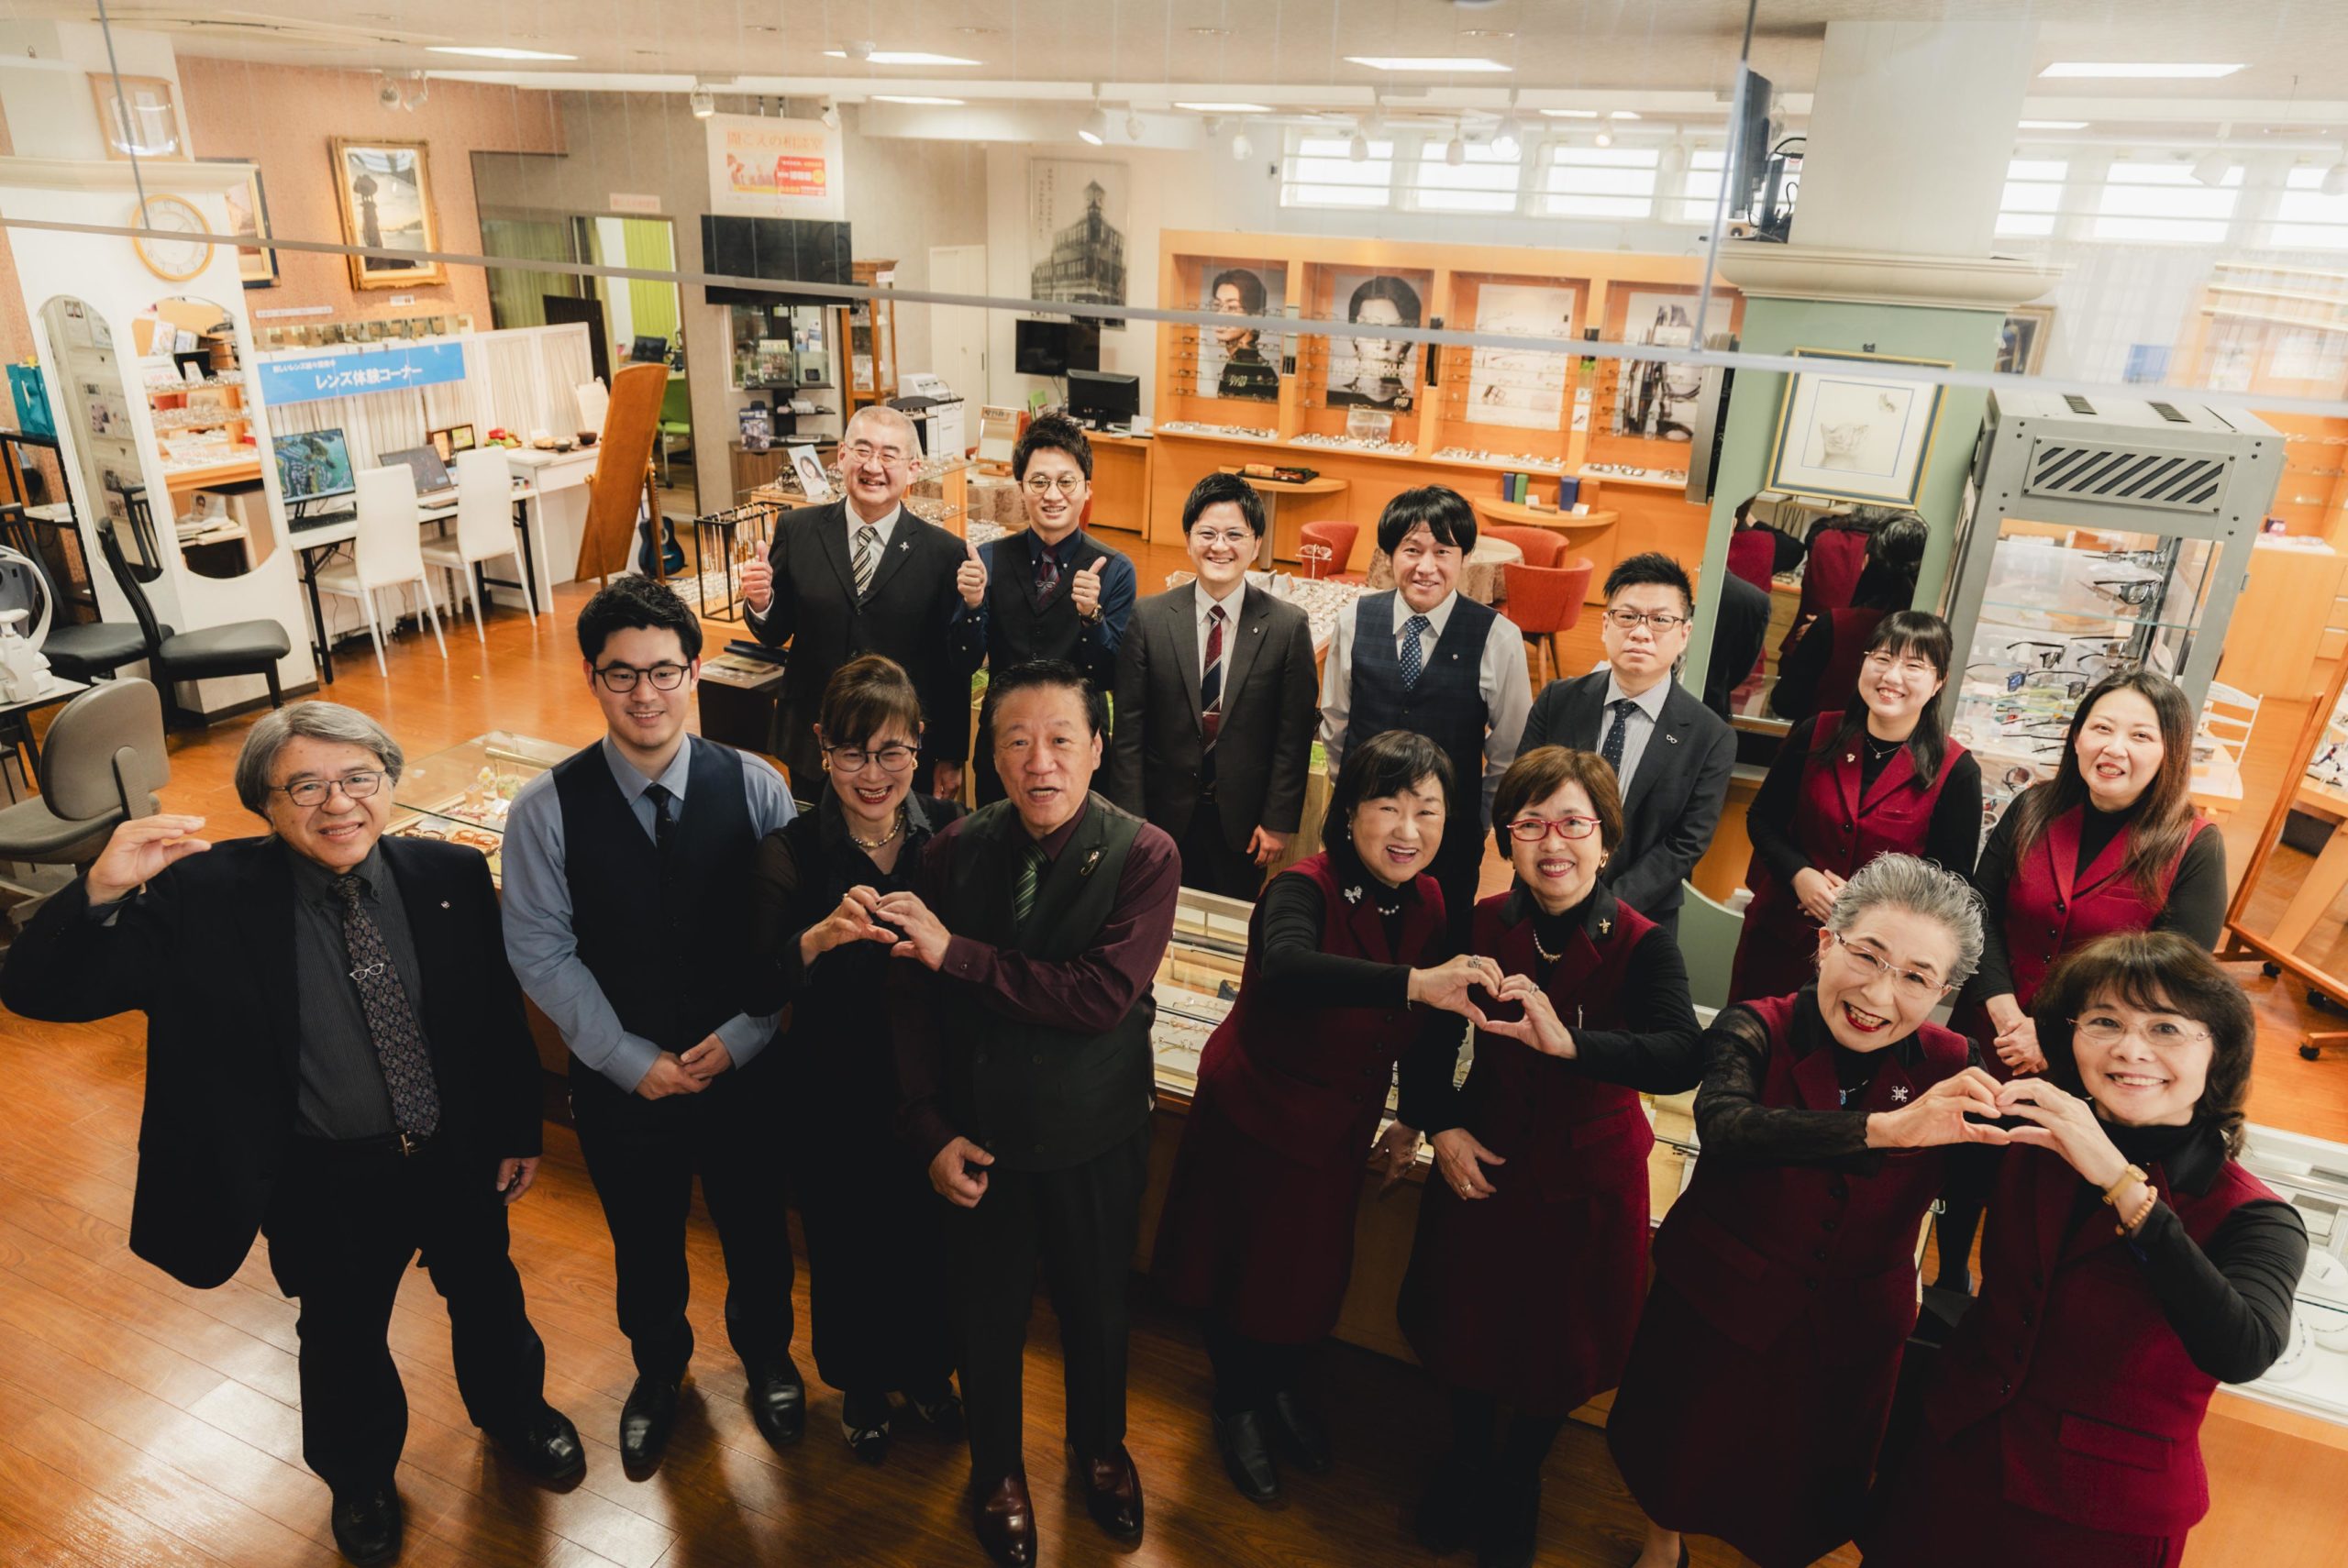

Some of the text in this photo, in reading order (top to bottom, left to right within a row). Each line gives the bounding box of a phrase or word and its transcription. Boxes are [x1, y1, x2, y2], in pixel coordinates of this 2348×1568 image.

[316, 365, 423, 391] レンズ体験コーナー
